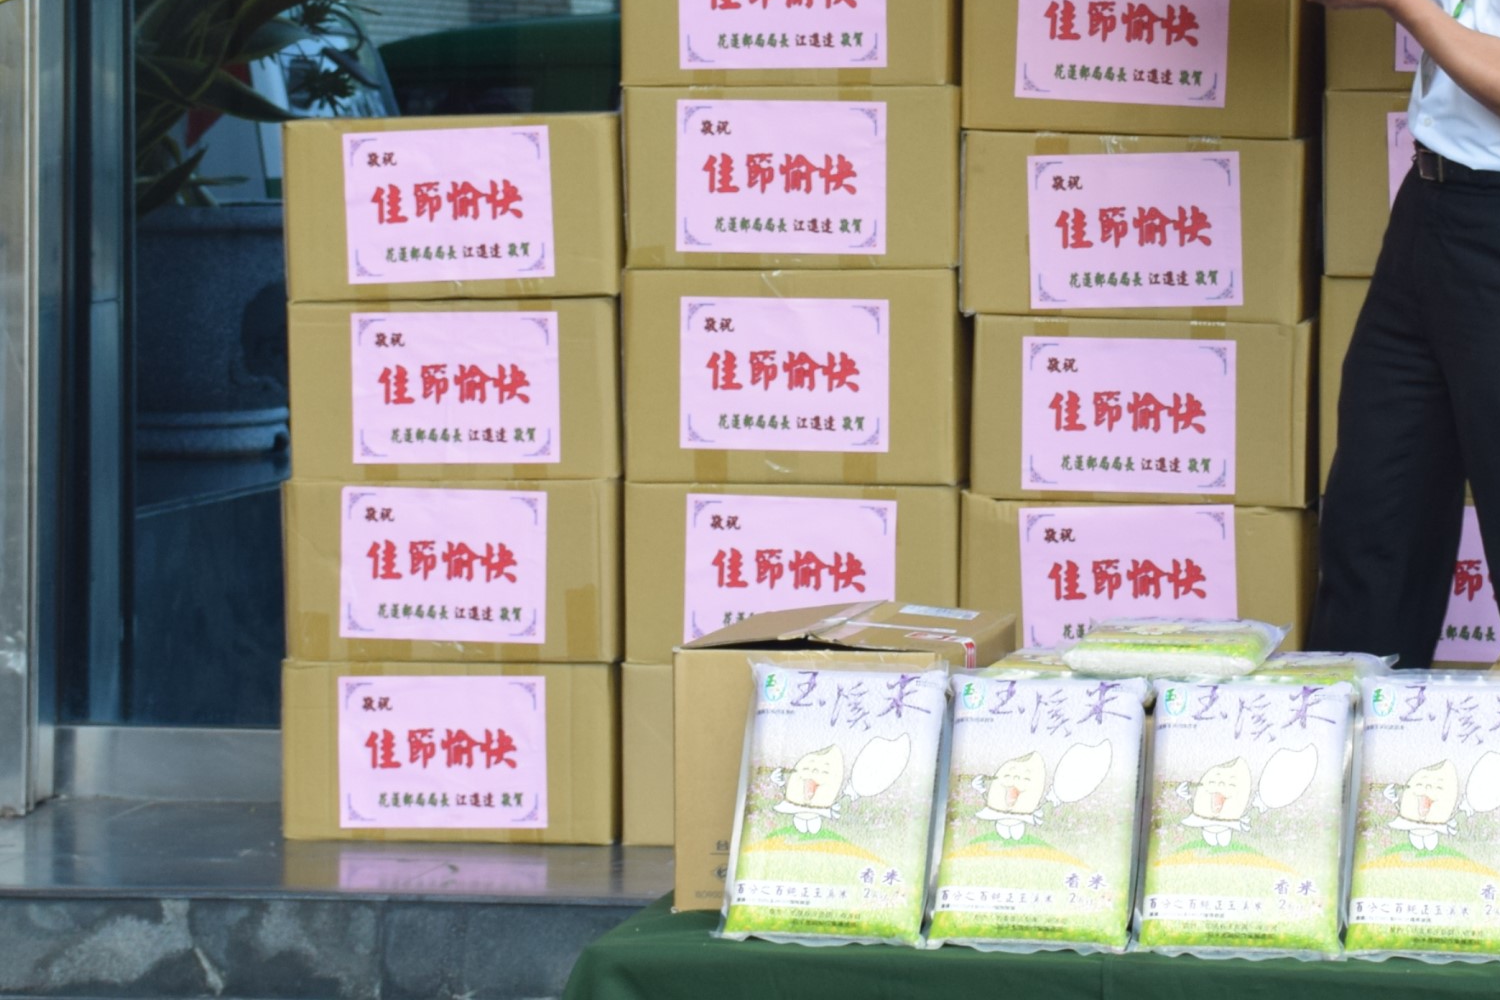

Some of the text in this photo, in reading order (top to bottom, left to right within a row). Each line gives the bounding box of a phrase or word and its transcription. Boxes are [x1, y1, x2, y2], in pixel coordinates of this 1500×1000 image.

[1045, 0, 1201, 47] 佳節愉快
[703, 153, 857, 195] 佳節愉快
[371, 179, 523, 224] 佳節愉快
[1055, 205, 1212, 249] 佳節愉快
[378, 364, 530, 405] 佳節愉快
[706, 350, 859, 392] 佳節愉快
[1049, 391, 1206, 434] 佳節愉快
[367, 540, 517, 583] 佳節愉快
[712, 548, 866, 593] 佳節愉快
[1048, 558, 1206, 600] 佳節愉快
[365, 728, 517, 769] 佳節愉快
